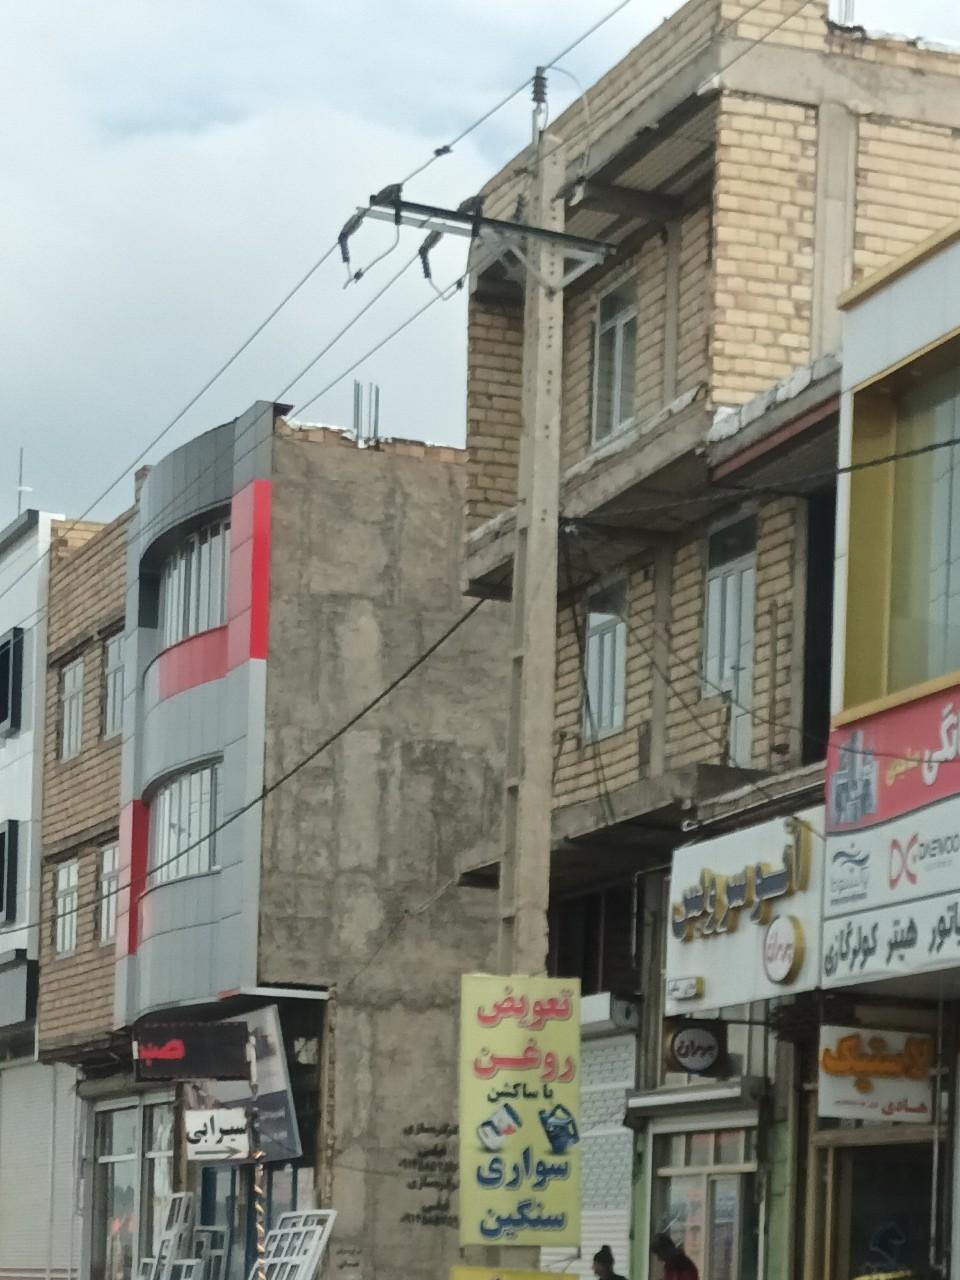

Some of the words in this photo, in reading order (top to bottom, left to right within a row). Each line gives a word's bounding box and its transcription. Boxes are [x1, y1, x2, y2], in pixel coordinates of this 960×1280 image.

[886, 917, 918, 965] هیتر
[476, 986, 574, 1030] تعویض
[472, 1038, 575, 1083] روغن
[186, 1114, 248, 1145] سیرابی
[475, 1146, 569, 1192] سواری
[479, 1199, 567, 1240] سنگین
